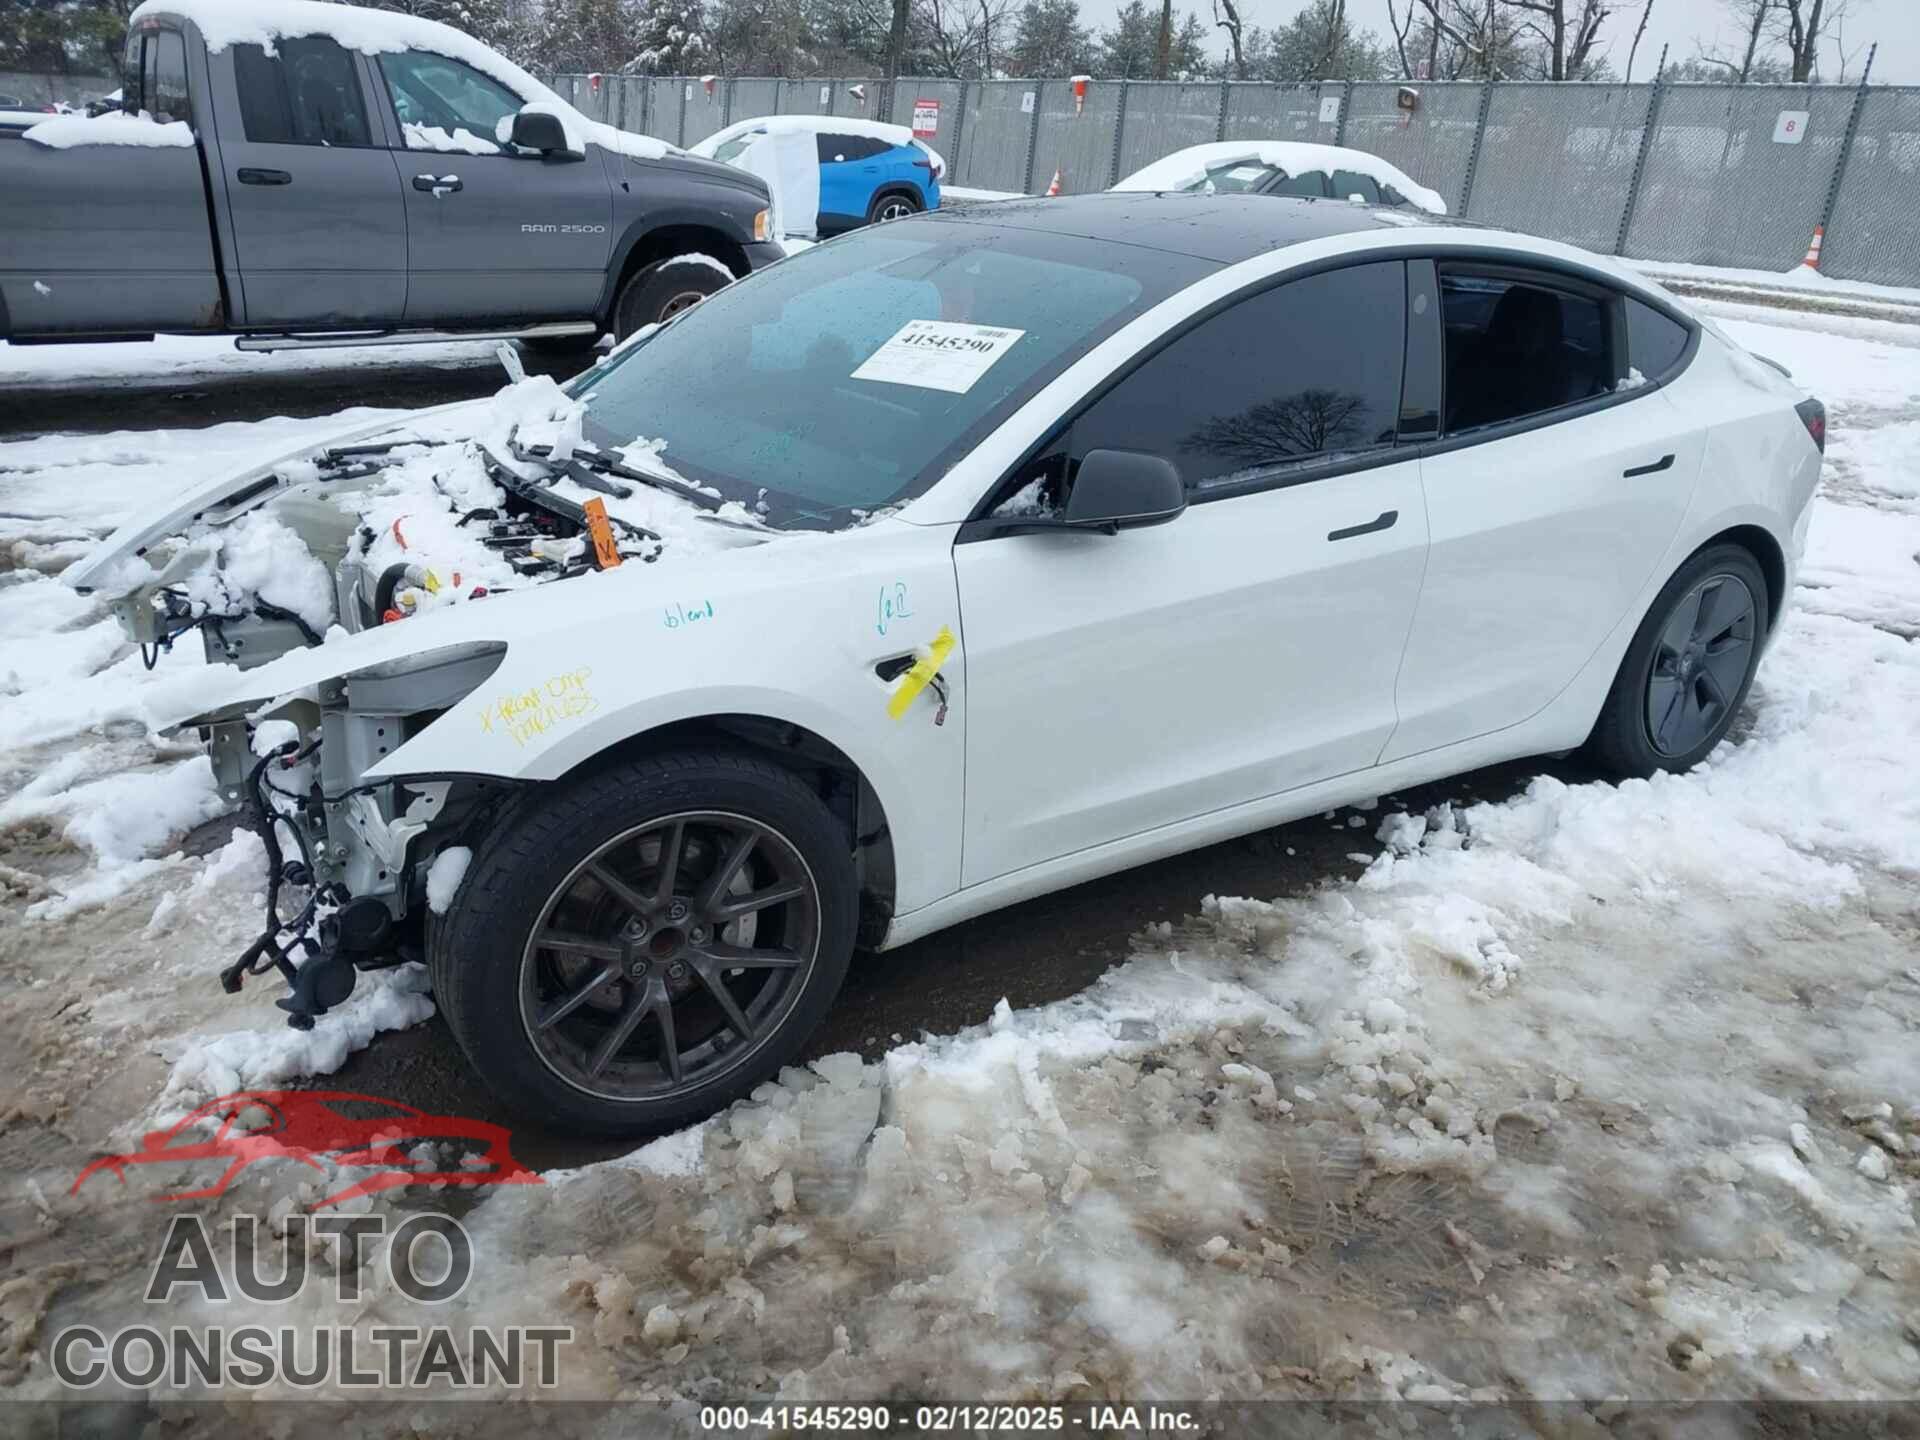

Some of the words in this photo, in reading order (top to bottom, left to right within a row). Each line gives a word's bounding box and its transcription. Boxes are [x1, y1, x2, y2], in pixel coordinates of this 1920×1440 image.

[1785, 120, 1797, 132] 8
[521, 224, 557, 233] RAM
[560, 224, 606, 233] 2500
[902, 333, 994, 353] 41545290
[664, 600, 713, 628] blend
